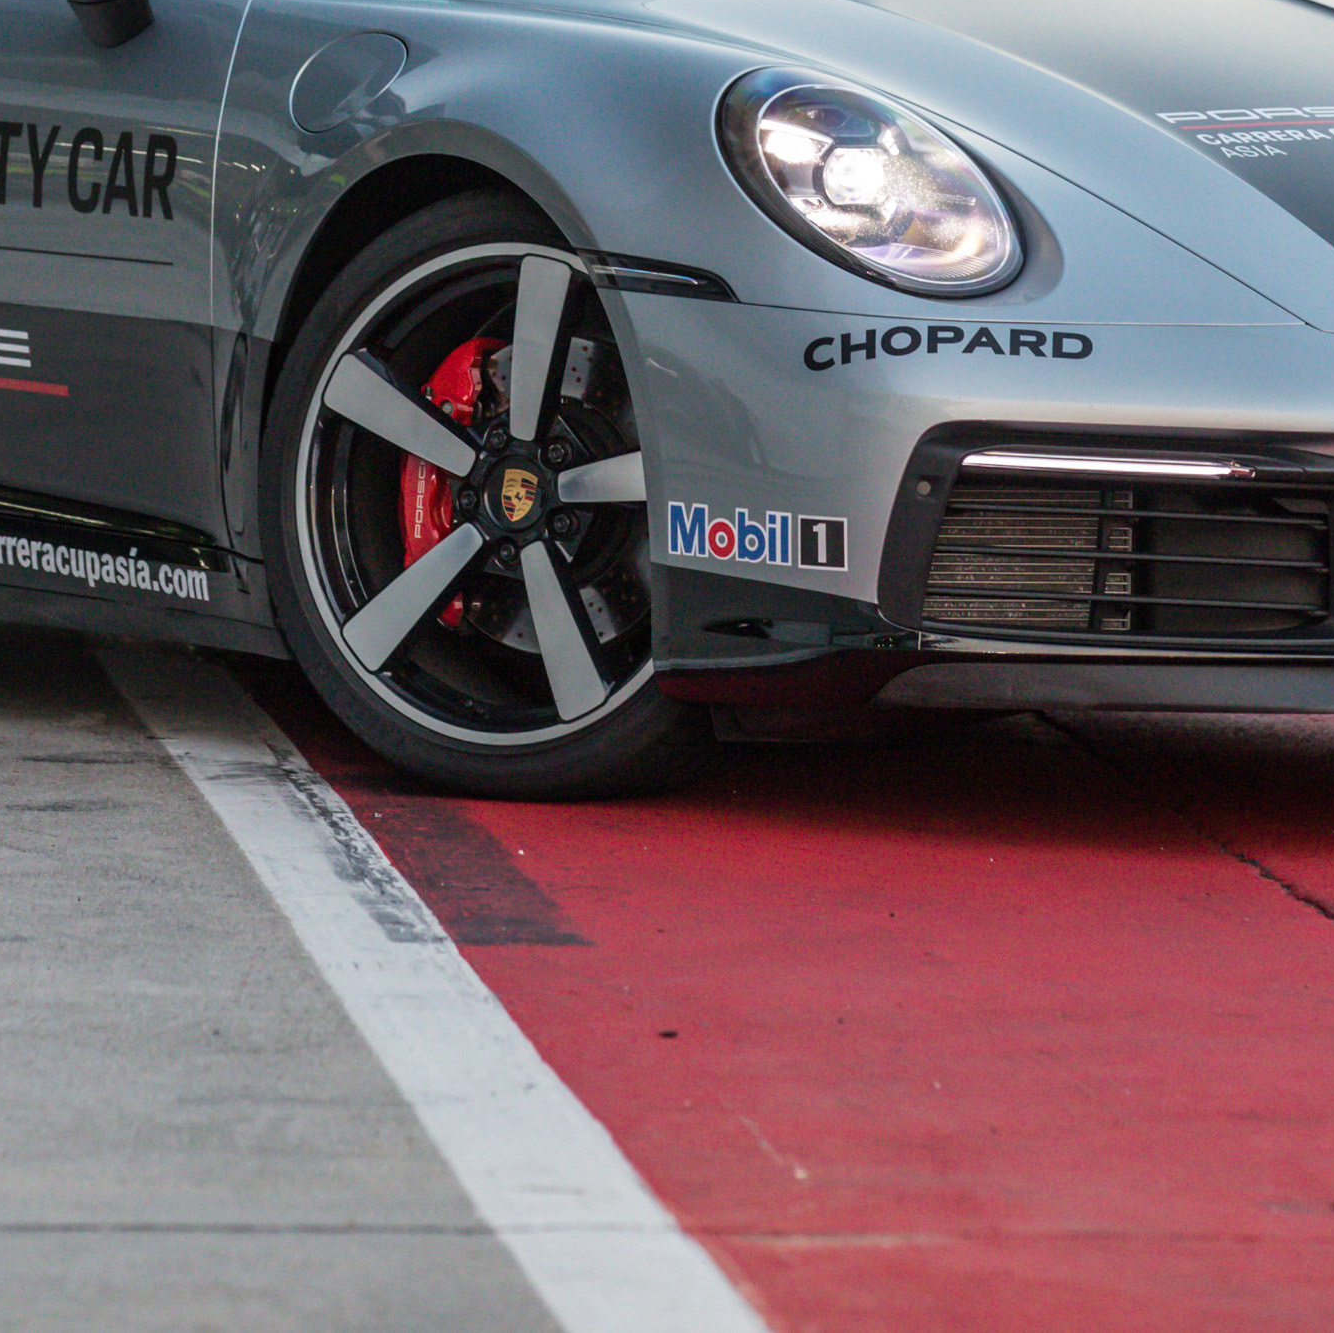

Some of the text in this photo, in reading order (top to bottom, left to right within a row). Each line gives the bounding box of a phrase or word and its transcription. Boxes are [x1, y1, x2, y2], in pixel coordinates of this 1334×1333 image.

[1196, 128, 1332, 145] CARRERA
[1220, 143, 1288, 159] ASIA
[68, 127, 178, 221] CAR
[803, 325, 1094, 371] CHOPARD
[414, 461, 426, 539] PORSC
[668, 501, 827, 565] Mobil 1
